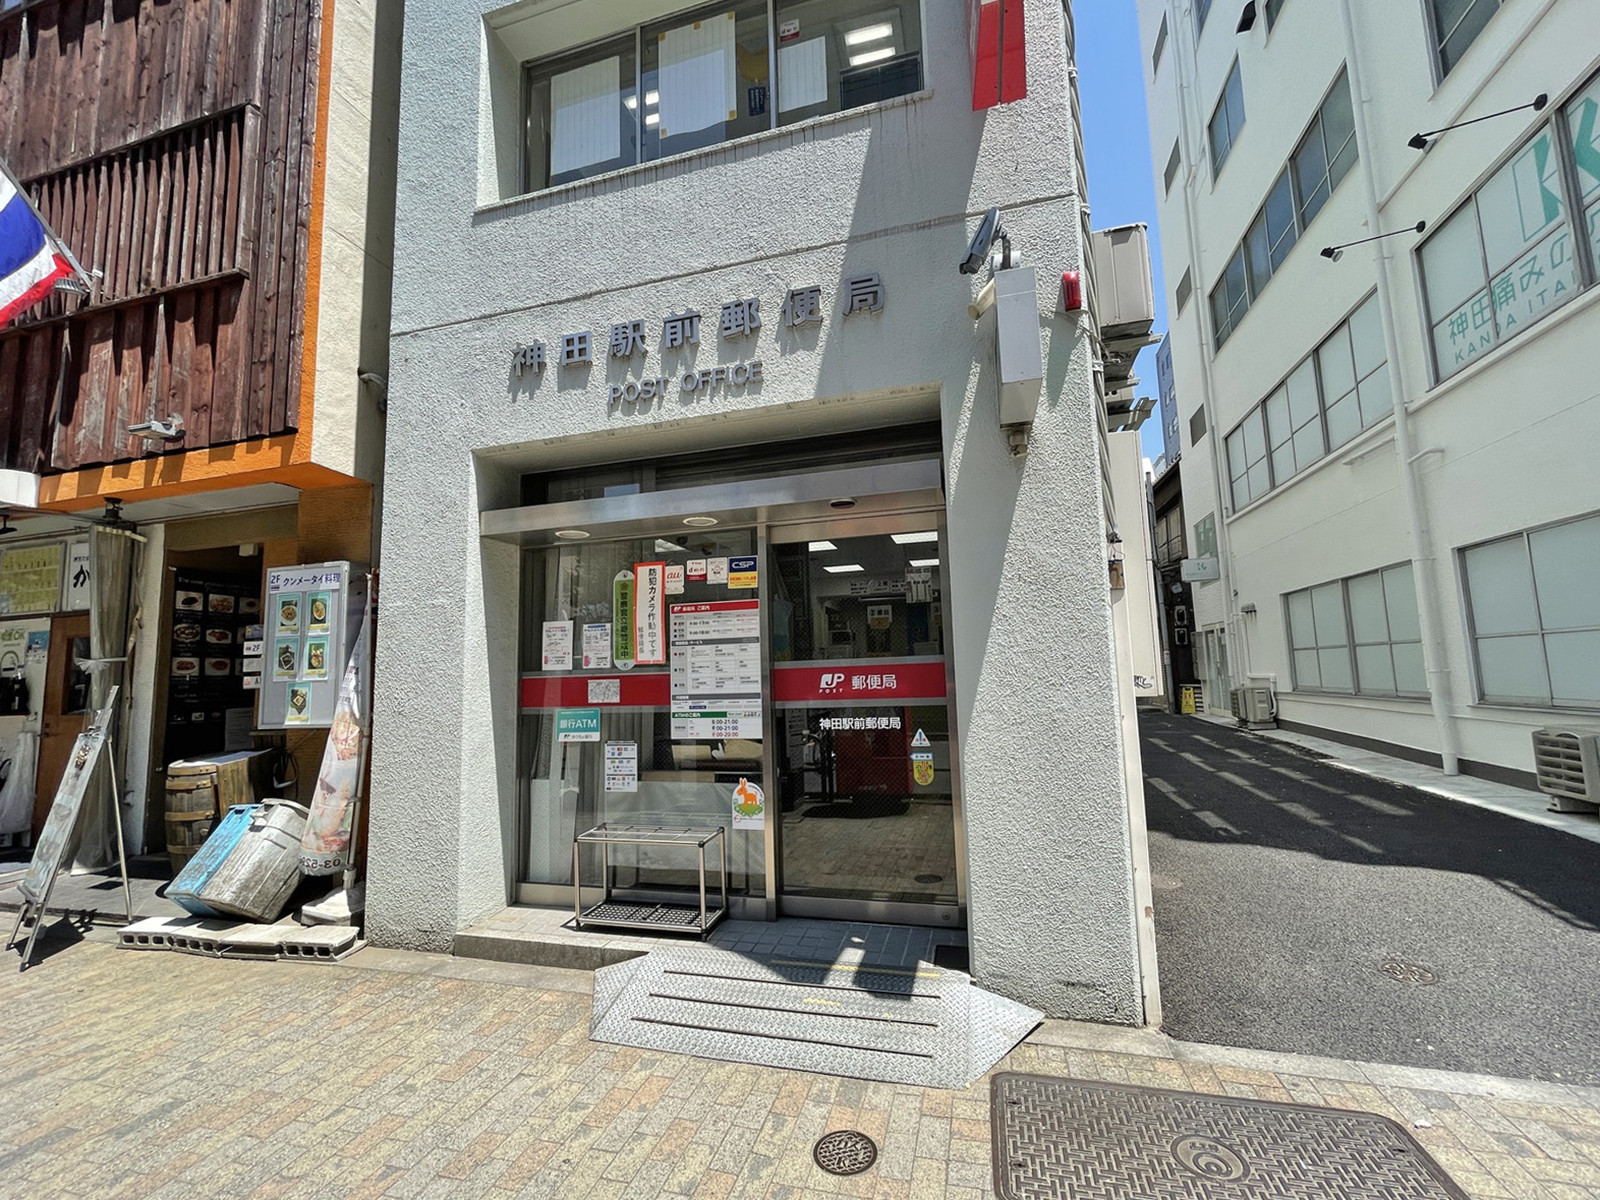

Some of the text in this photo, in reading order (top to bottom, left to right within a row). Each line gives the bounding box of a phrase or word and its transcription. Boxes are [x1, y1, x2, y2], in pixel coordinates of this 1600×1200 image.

[512, 272, 885, 377] 神田駅前郵便局
[609, 361, 763, 404] POST OFFICE
[271, 573, 341, 586] 2F クンメータイ料理
[648, 568, 656, 657] 防犯カメラ作動中です
[852, 674, 897, 690] 郵便局
[560, 718, 597, 729] 銀行ATM
[819, 717, 901, 730] 神田駅前郵便局
